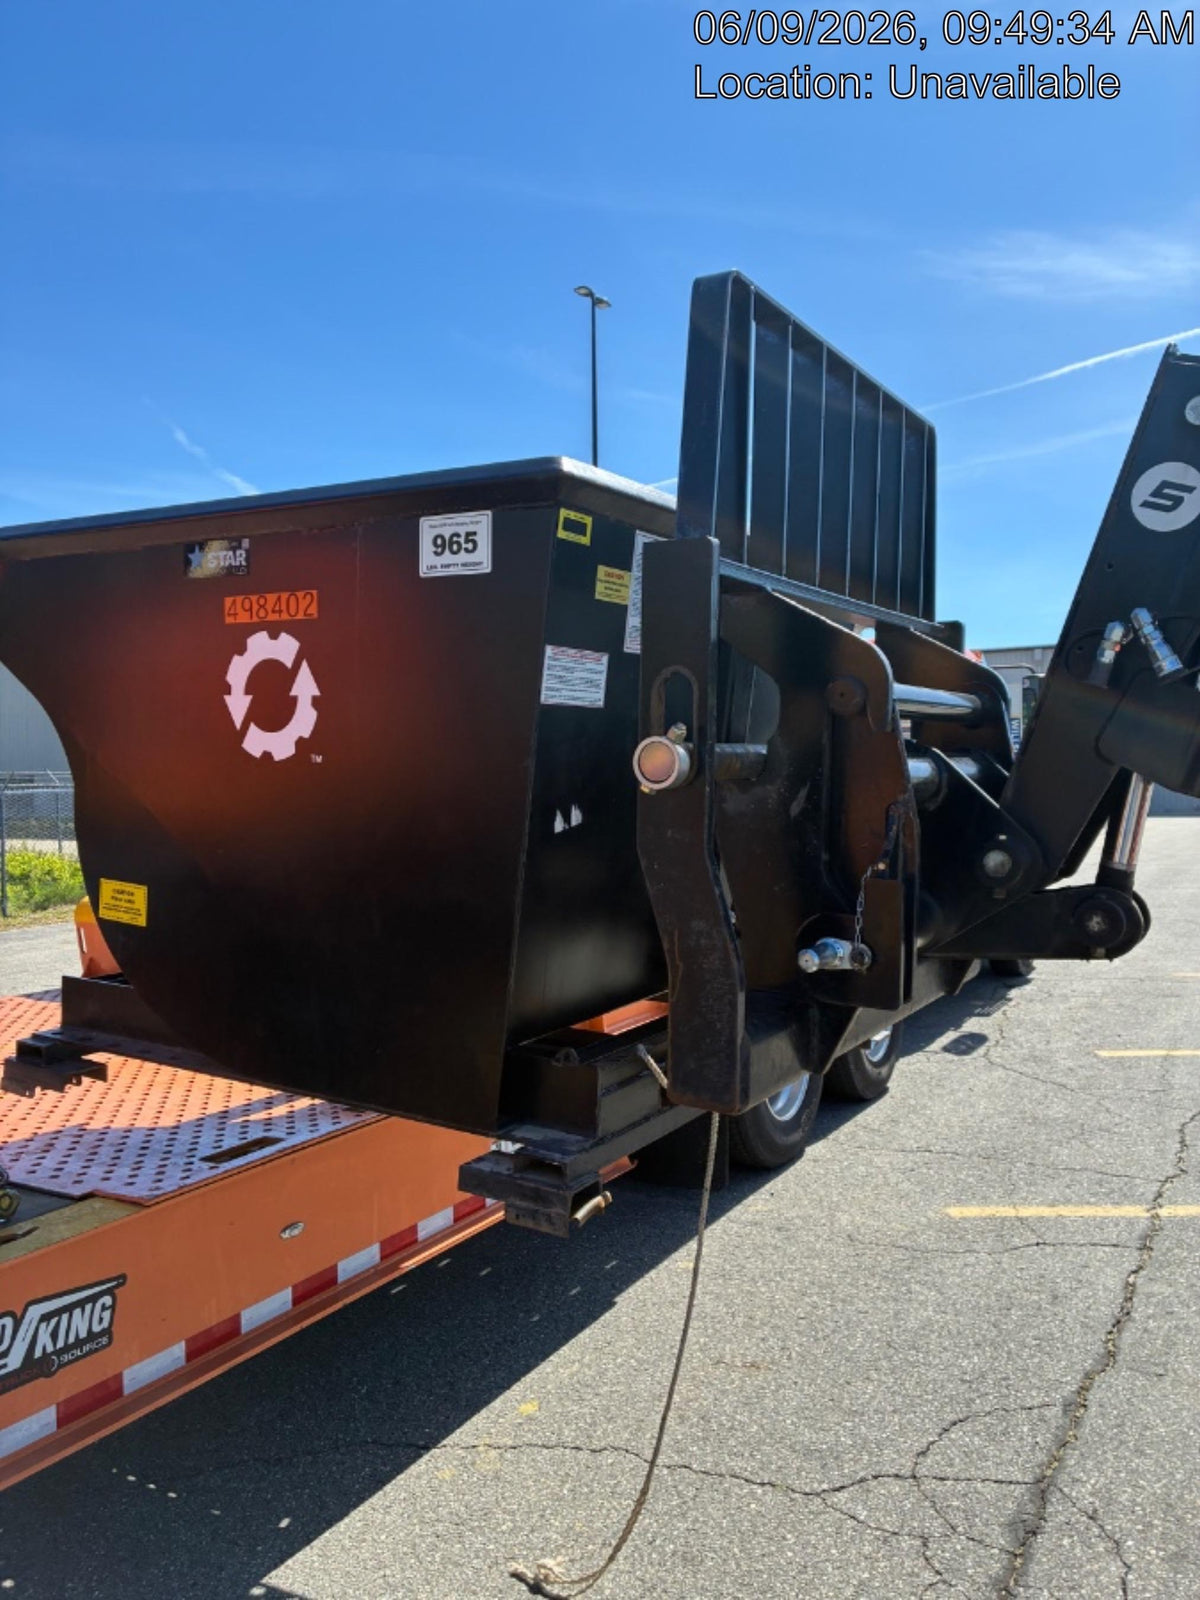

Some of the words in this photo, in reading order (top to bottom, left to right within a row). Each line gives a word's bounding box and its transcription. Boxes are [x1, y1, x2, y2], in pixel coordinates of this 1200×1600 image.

[431, 530, 479, 557] 965
[207, 549, 247, 568] STAR
[226, 591, 315, 622] 498402
[310, 753, 323, 764] TM
[33, 1294, 113, 1360] KING
